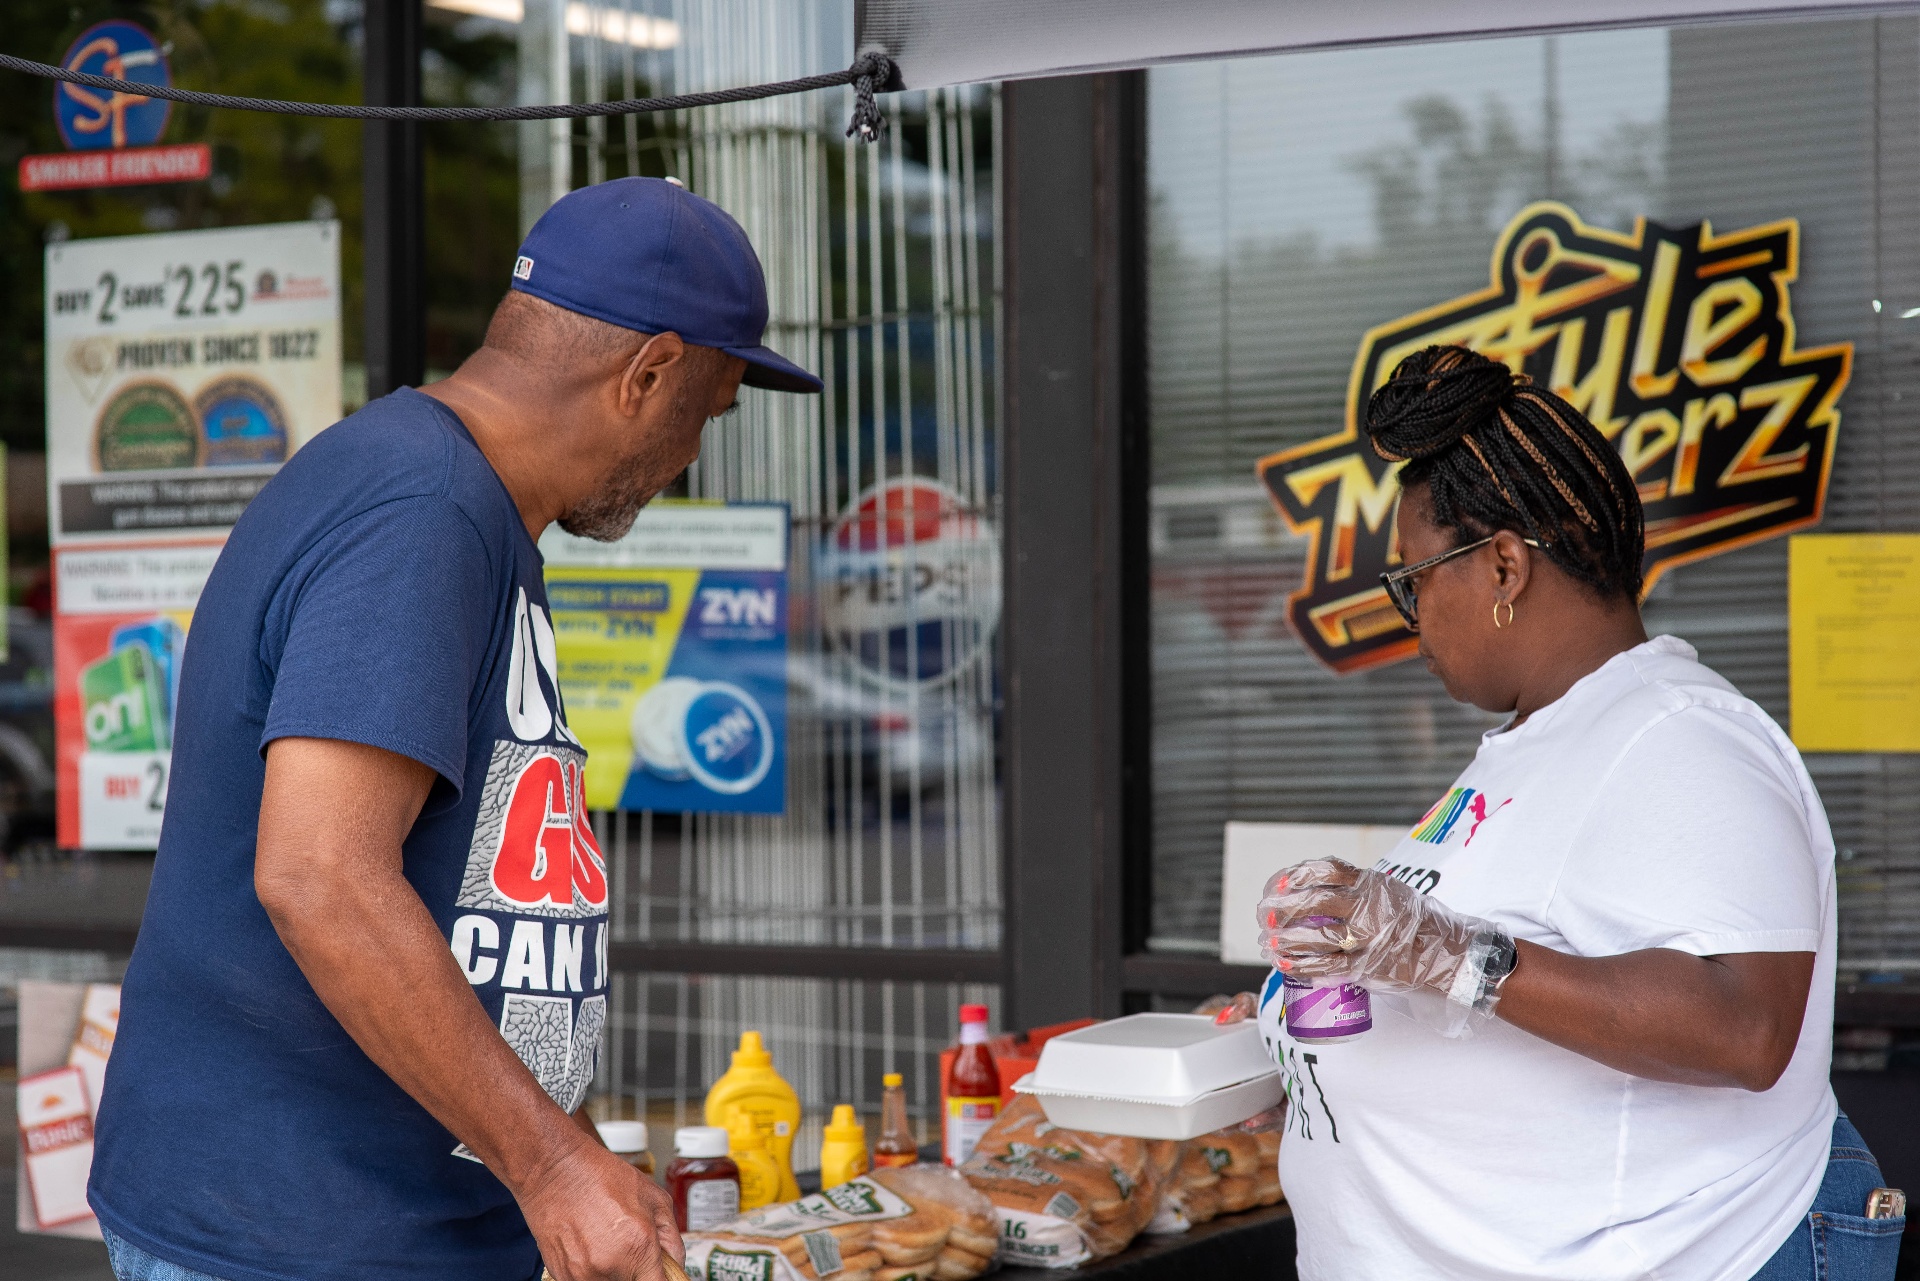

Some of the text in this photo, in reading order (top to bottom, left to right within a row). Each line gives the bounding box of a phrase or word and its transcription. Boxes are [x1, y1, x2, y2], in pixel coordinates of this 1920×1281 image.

[54, 288, 93, 315] BUY
[97, 270, 118, 324] 2
[121, 283, 166, 310] SAVE
[117, 336, 194, 369] PROVEN
[201, 332, 260, 365] SINCE
[1286, 374, 1819, 582] Merz
[604, 615, 656, 640] ZYN
[699, 585, 778, 627] ZYN
[696, 706, 754, 764] ZYN
[105, 760, 166, 813] BUY 2
[452, 914, 584, 992] CAN
[1004, 1218, 1027, 1240] 16
